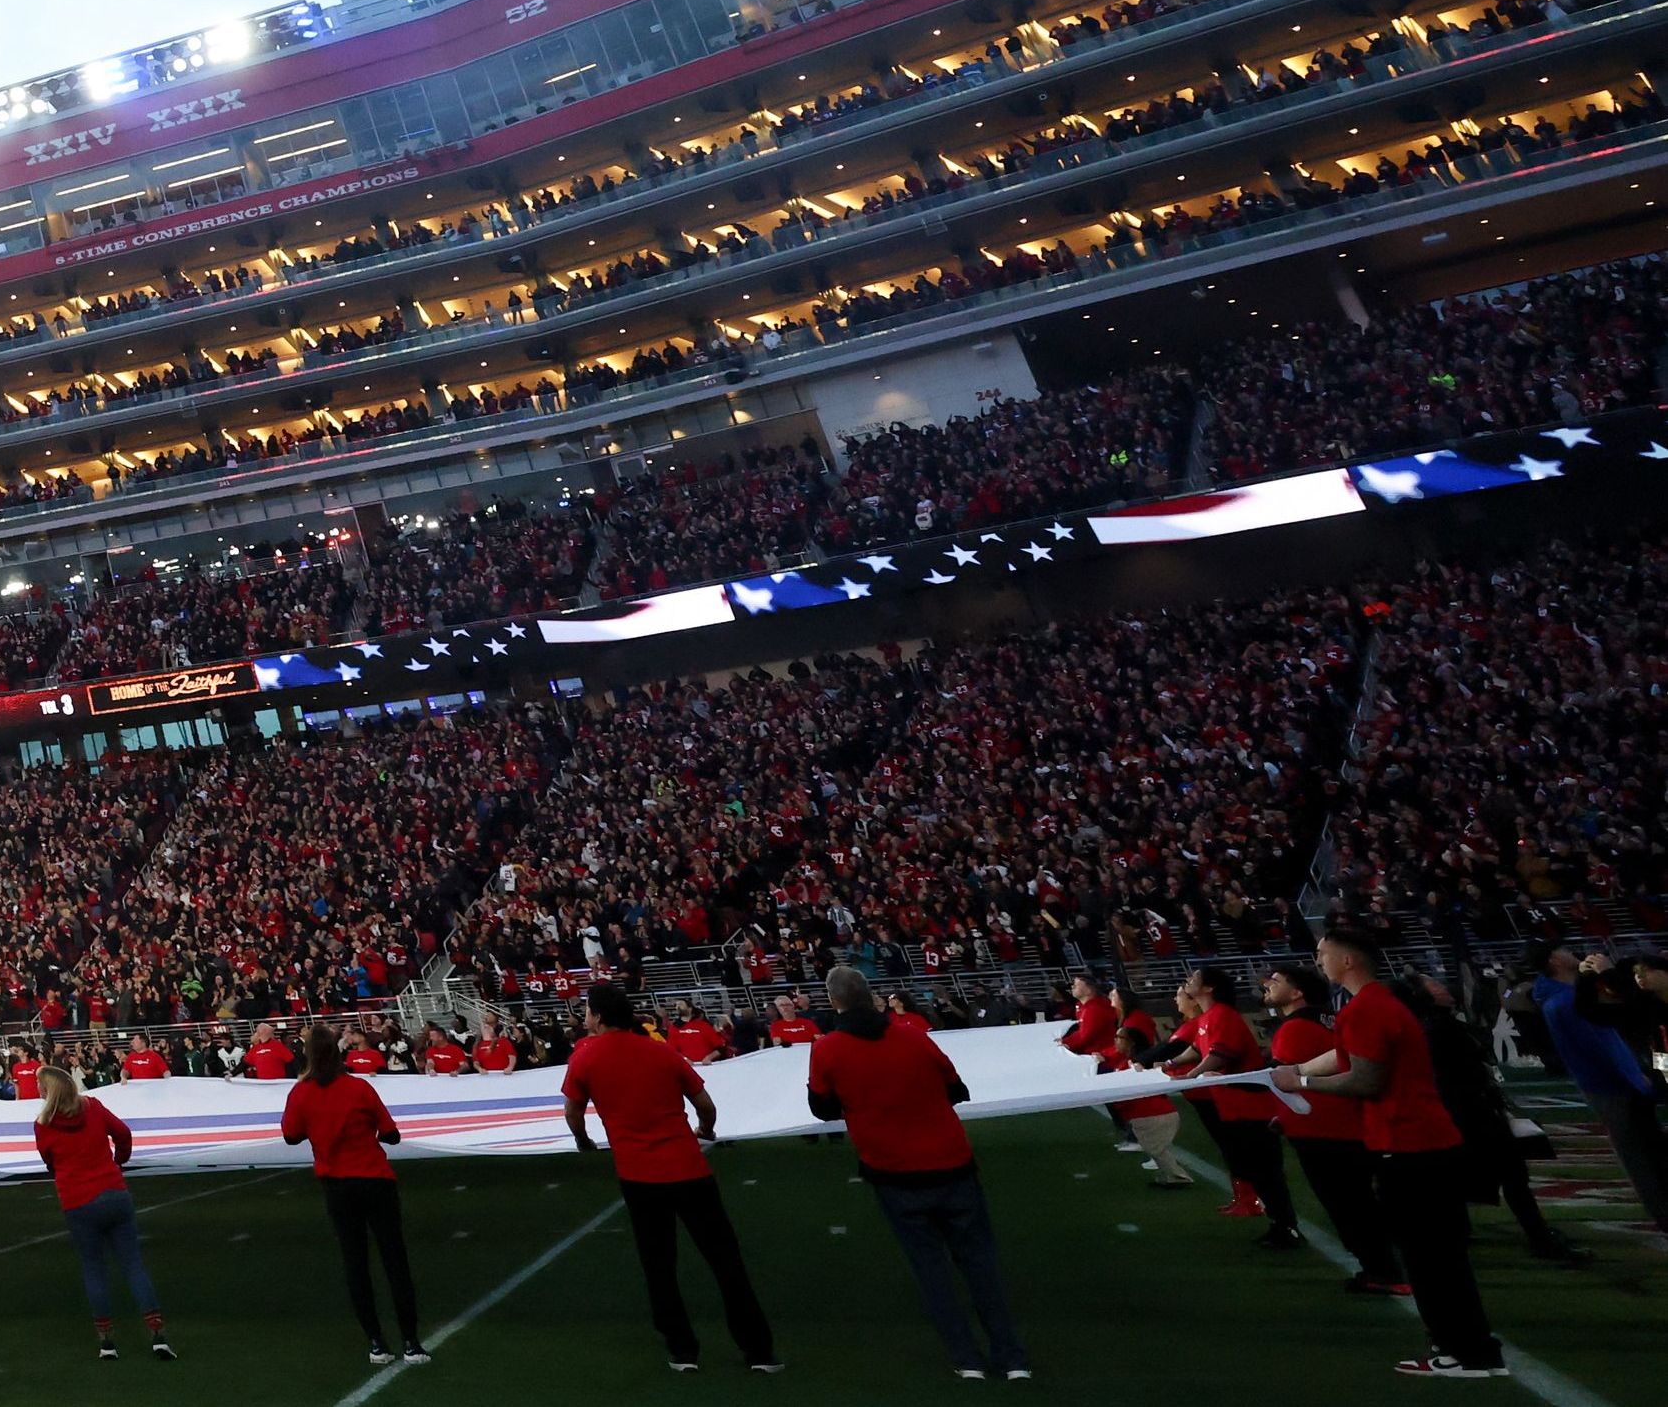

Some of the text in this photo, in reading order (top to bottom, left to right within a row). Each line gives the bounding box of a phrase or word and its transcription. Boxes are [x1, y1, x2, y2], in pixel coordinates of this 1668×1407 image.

[146, 88, 246, 132] XXIX
[23, 123, 118, 167] XXIV
[55, 167, 419, 266] 8-TIME CONFERENCE CHAMPIONS
[61, 694, 75, 716] 3
[110, 671, 237, 701] HOME OF THE Faithful
